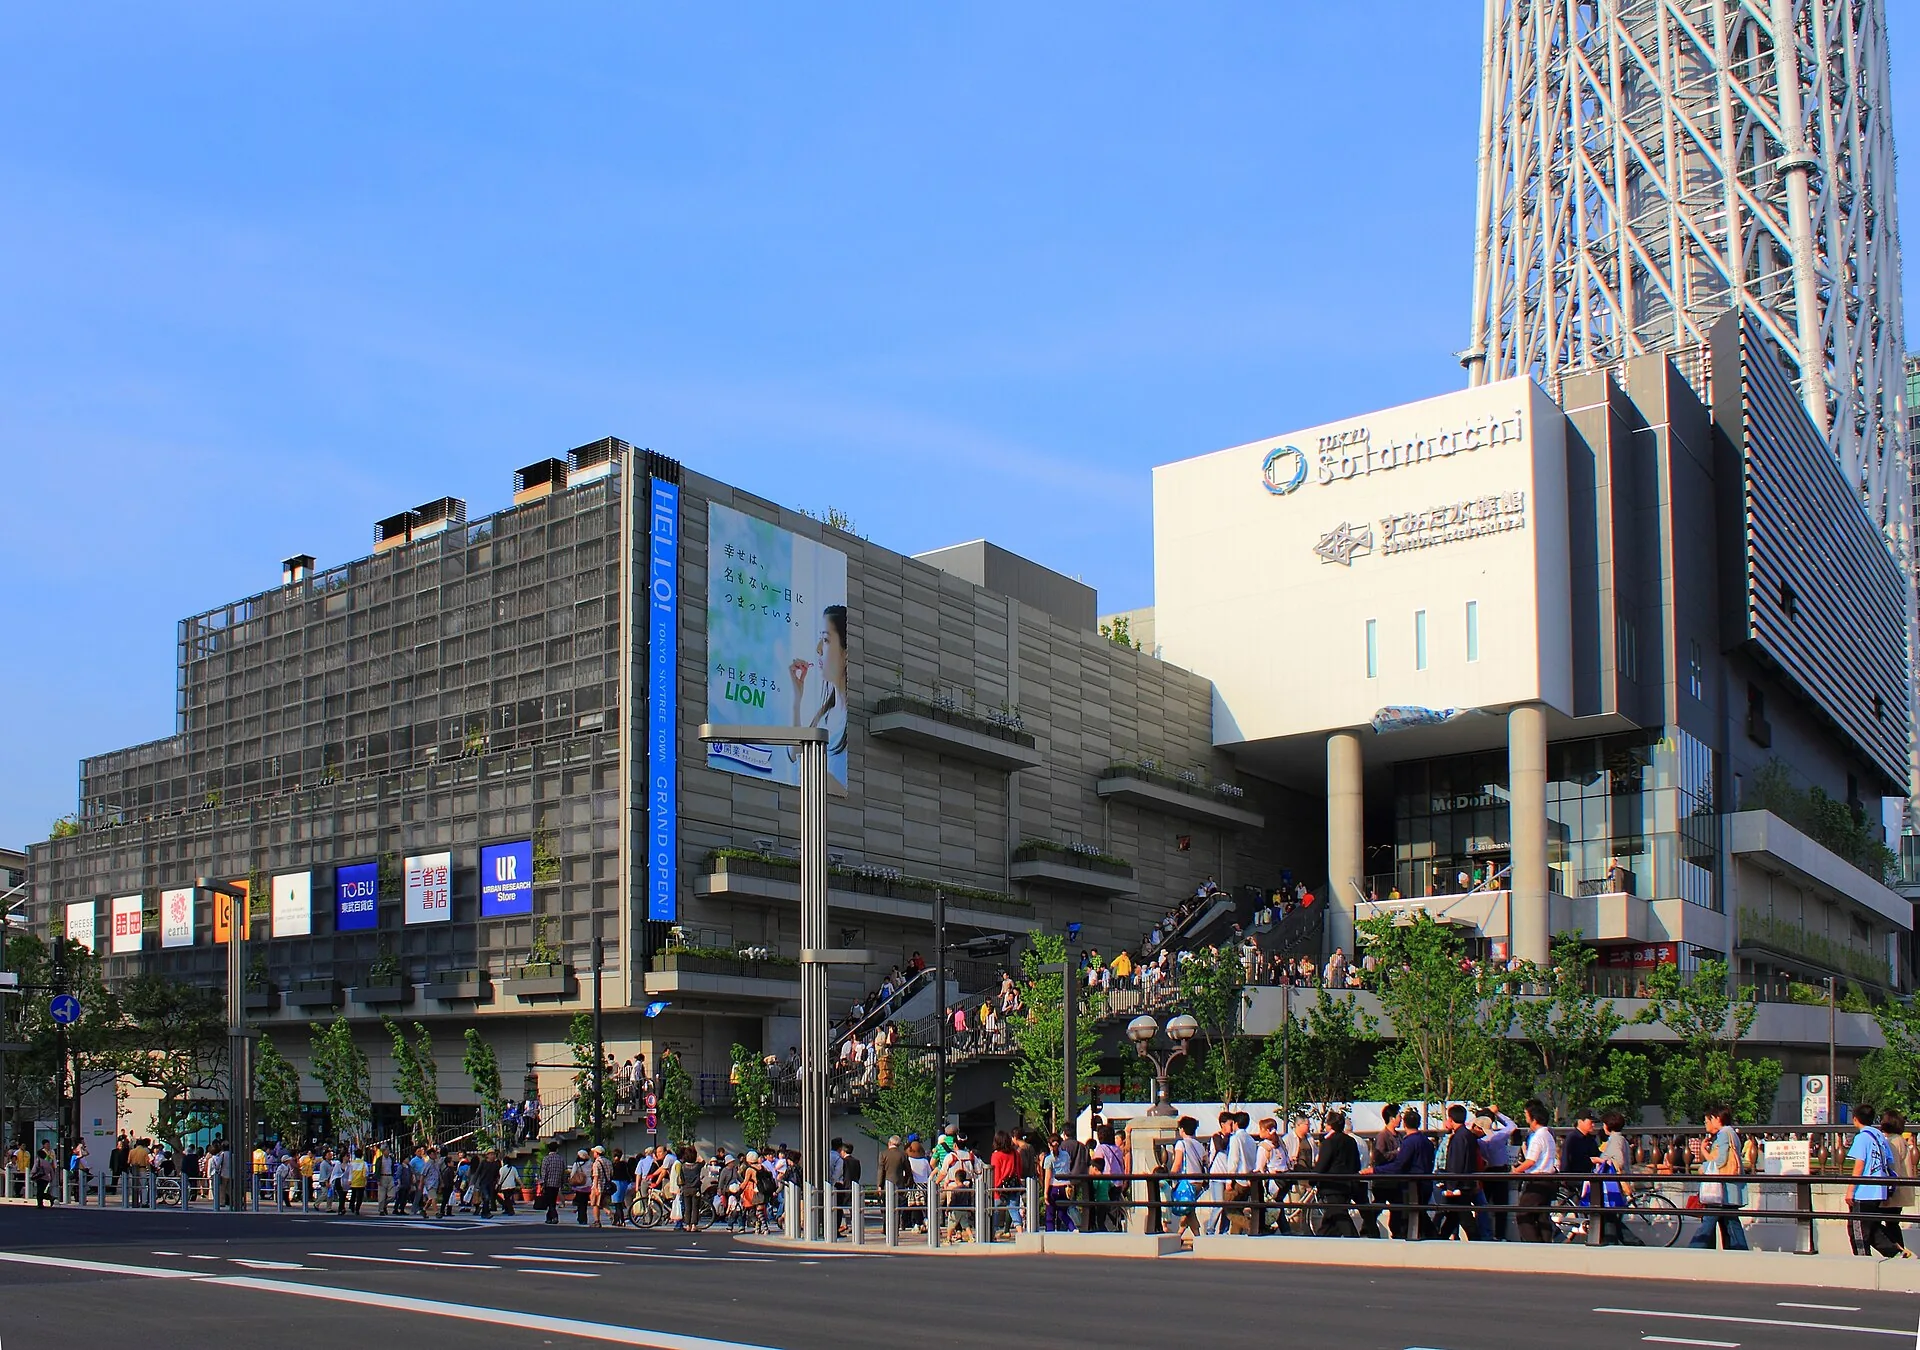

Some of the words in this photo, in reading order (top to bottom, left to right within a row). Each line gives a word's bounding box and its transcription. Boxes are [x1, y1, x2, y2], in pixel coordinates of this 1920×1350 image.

[1316, 410, 1522, 485] Solamachi
[1379, 491, 1525, 540] すみだ水族館
[654, 489, 673, 613] HELLO!
[724, 543, 766, 571] 幸せは、
[724, 567, 804, 605] 名もない一日に
[724, 592, 800, 628] つまっている。
[659, 622, 667, 664] TOKYO
[716, 662, 782, 693] 今日を愛する。
[659, 669, 667, 723] SKYTREE
[725, 681, 766, 709] LION
[656, 776, 669, 846] GRAND
[1432, 795, 1507, 811] McDona
[410, 865, 447, 888] 三省堂
[496, 855, 517, 881] UR
[341, 880, 374, 898] TOBU
[483, 885, 501, 895] URBAN
[502, 881, 531, 892] RESEARCH
[497, 891, 517, 902] Store
[656, 853, 669, 914] OPEN!
[341, 900, 374, 913] 東武百貨店
[423, 890, 447, 910] 書店
[69, 917, 94, 929] CHEESE
[69, 928, 94, 940] GARDEN
[167, 926, 189, 937] earth
